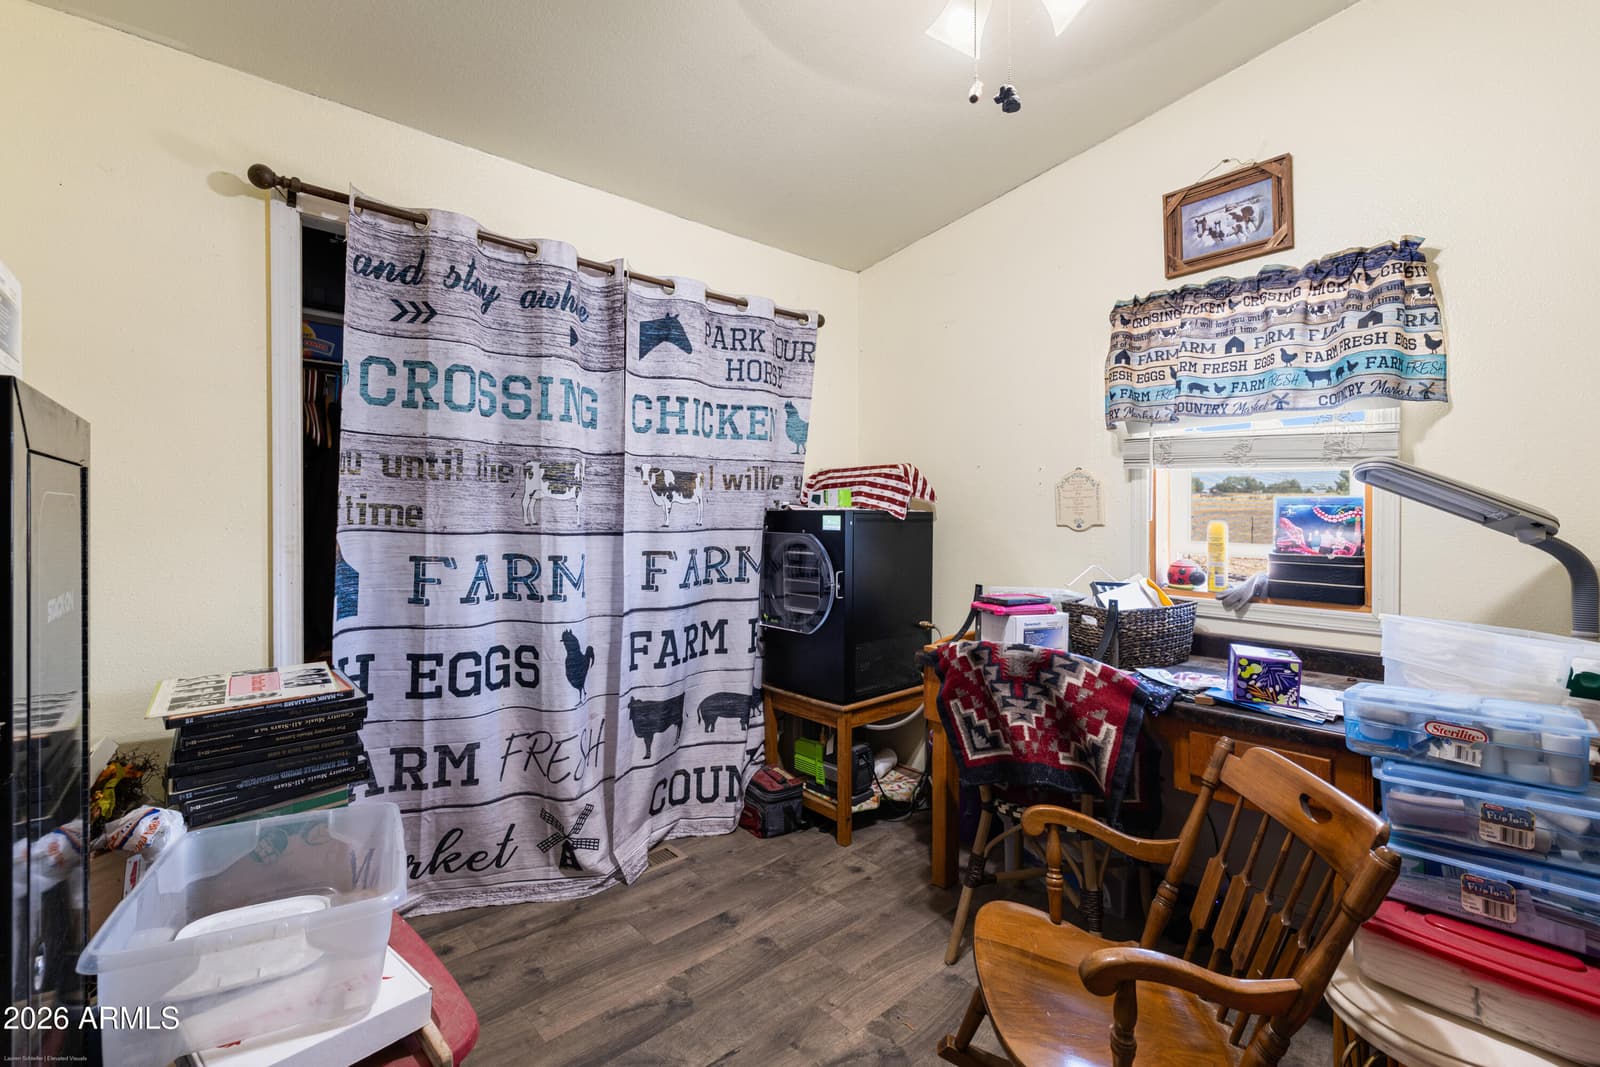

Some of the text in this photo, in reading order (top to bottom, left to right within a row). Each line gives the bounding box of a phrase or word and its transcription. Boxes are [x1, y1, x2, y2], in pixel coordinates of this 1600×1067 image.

[352, 249, 425, 286] and
[443, 257, 501, 315] stay
[1200, 320, 1213, 329] will
[1230, 316, 1245, 326] you
[1396, 307, 1440, 327] FRM
[1240, 326, 1258, 334] time
[1253, 327, 1296, 349] FARM
[704, 321, 815, 363] PARK OUR
[1339, 331, 1388, 353] FRESH
[1137, 348, 1179, 365] FARM
[1202, 360, 1248, 374] FRESH
[1254, 353, 1275, 370] EGGS
[725, 358, 784, 389] HORSE
[1136, 370, 1166, 384] EGGS
[359, 355, 599, 430] CROSSING
[1120, 388, 1151, 402] FARM
[1231, 378, 1266, 393] FARM
[1318, 382, 1365, 406] COTRY
[631, 393, 778, 442] CHICKEN
[1175, 401, 1229, 415] OUNTRY
[379, 448, 464, 481] until
[722, 465, 765, 491] will
[346, 493, 424, 527] time
[408, 553, 586, 607] FARM
[629, 619, 728, 672] FARM
[405, 645, 540, 700] EGGS
[271, 721, 303, 731] All-Stars
[304, 716, 326, 725] Music
[328, 711, 354, 721] Country
[1431, 723, 1481, 741] Sterilite
[500, 719, 606, 784] FRESH
[307, 771, 328, 782] Music
[329, 766, 356, 777] Country
[273, 777, 306, 790] All-Stars
